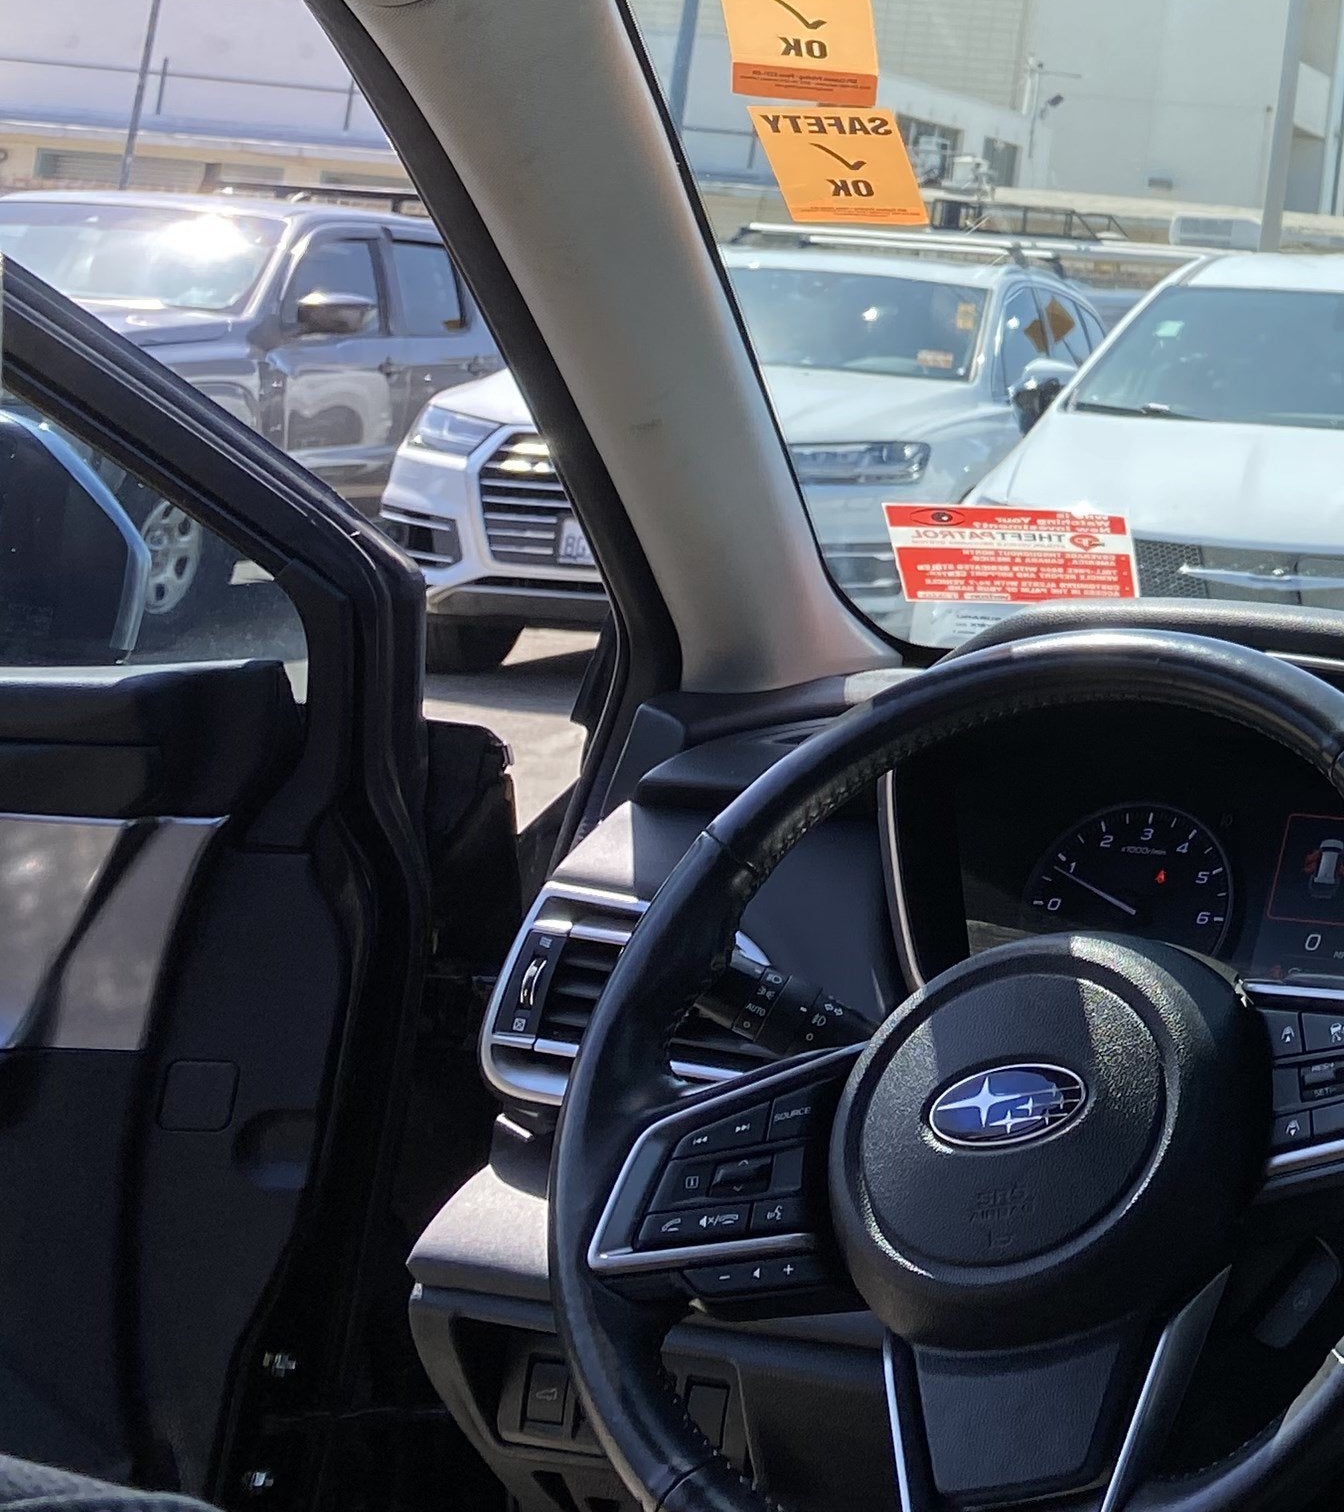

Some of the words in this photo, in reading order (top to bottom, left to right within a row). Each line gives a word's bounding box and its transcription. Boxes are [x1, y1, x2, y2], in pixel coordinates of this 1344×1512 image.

[1100, 834, 1114, 848] 2
[1140, 828, 1154, 841] 3
[1176, 841, 1189, 854] 4
[1069, 861, 1076, 874] 1
[1195, 871, 1211, 885] 5
[1048, 897, 1062, 911] 0
[1196, 911, 1211, 925] 6
[1304, 933, 1321, 951] 0
[745, 1002, 767, 1017] AUTO
[773, 1106, 812, 1123] SOURCE
